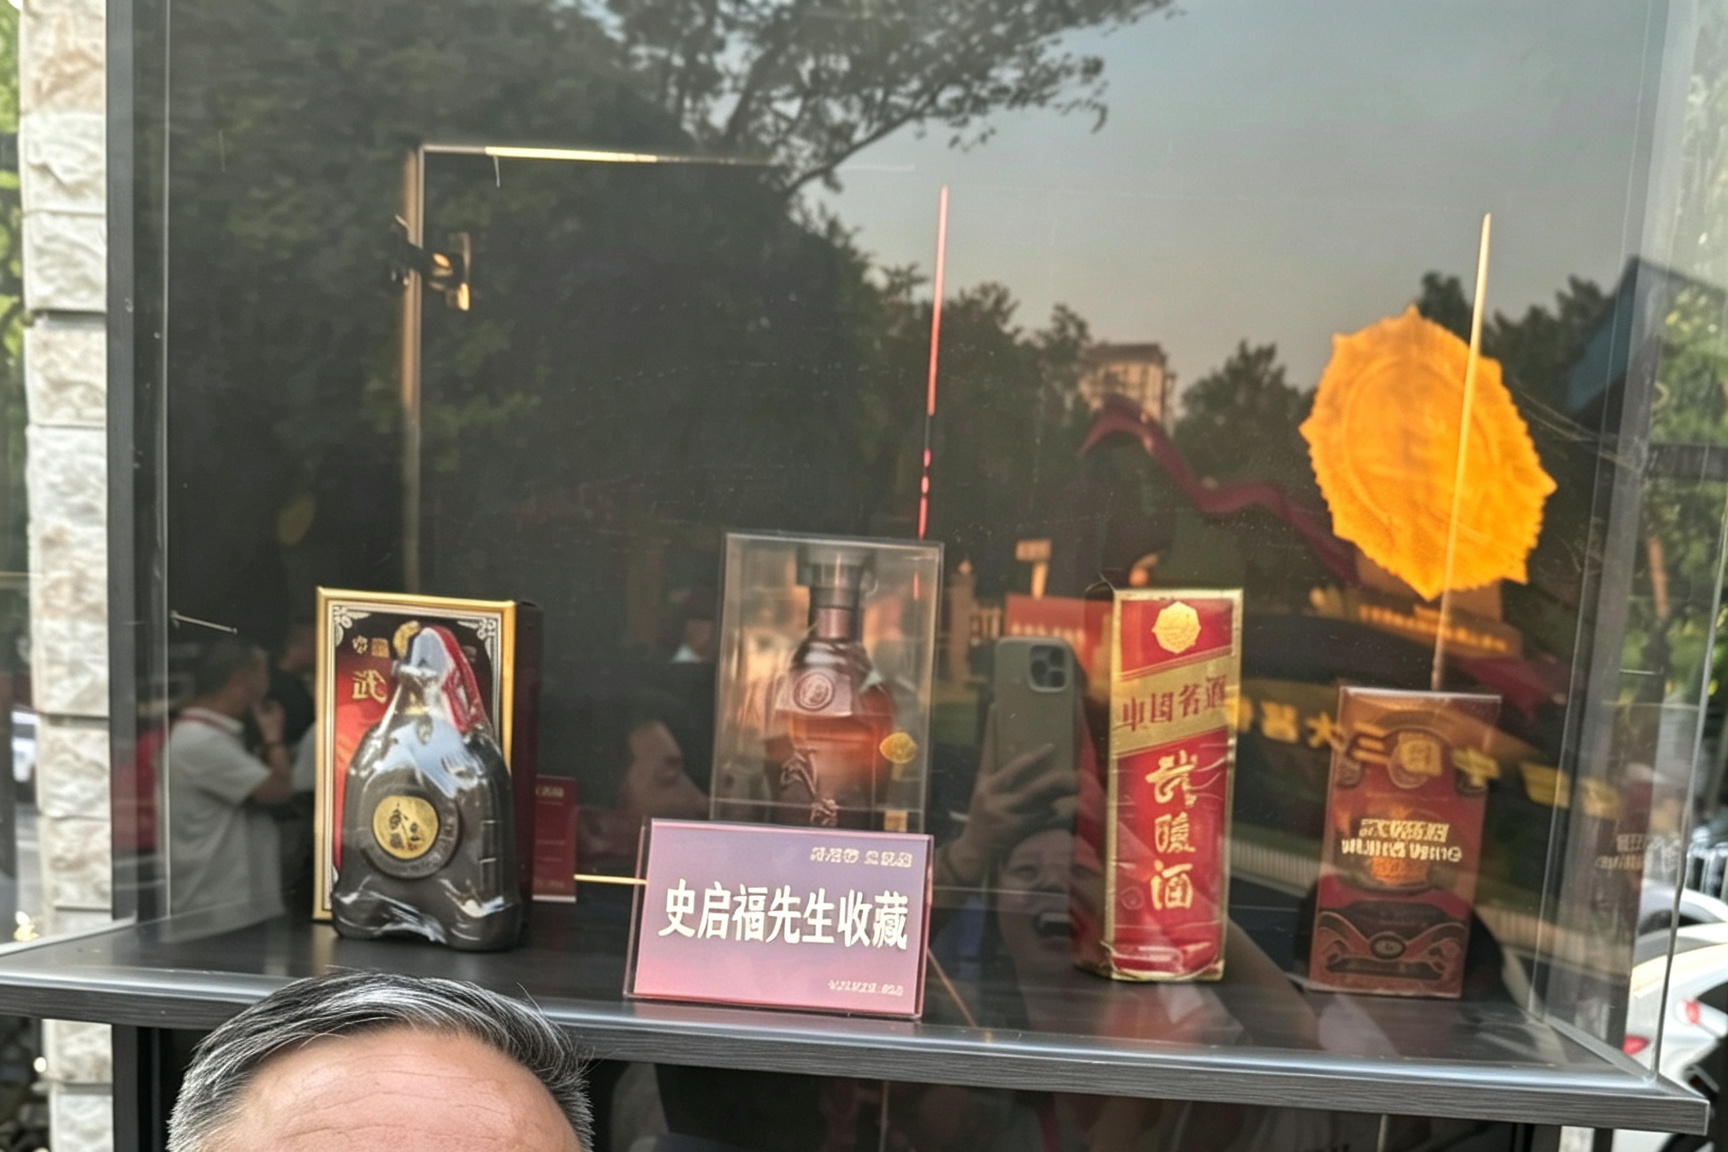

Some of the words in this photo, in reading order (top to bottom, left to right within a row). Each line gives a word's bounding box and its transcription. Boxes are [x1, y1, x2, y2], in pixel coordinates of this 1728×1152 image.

[1121, 674, 1227, 732] 中国名酒
[658, 878, 909, 951] 史启福先生收藏
